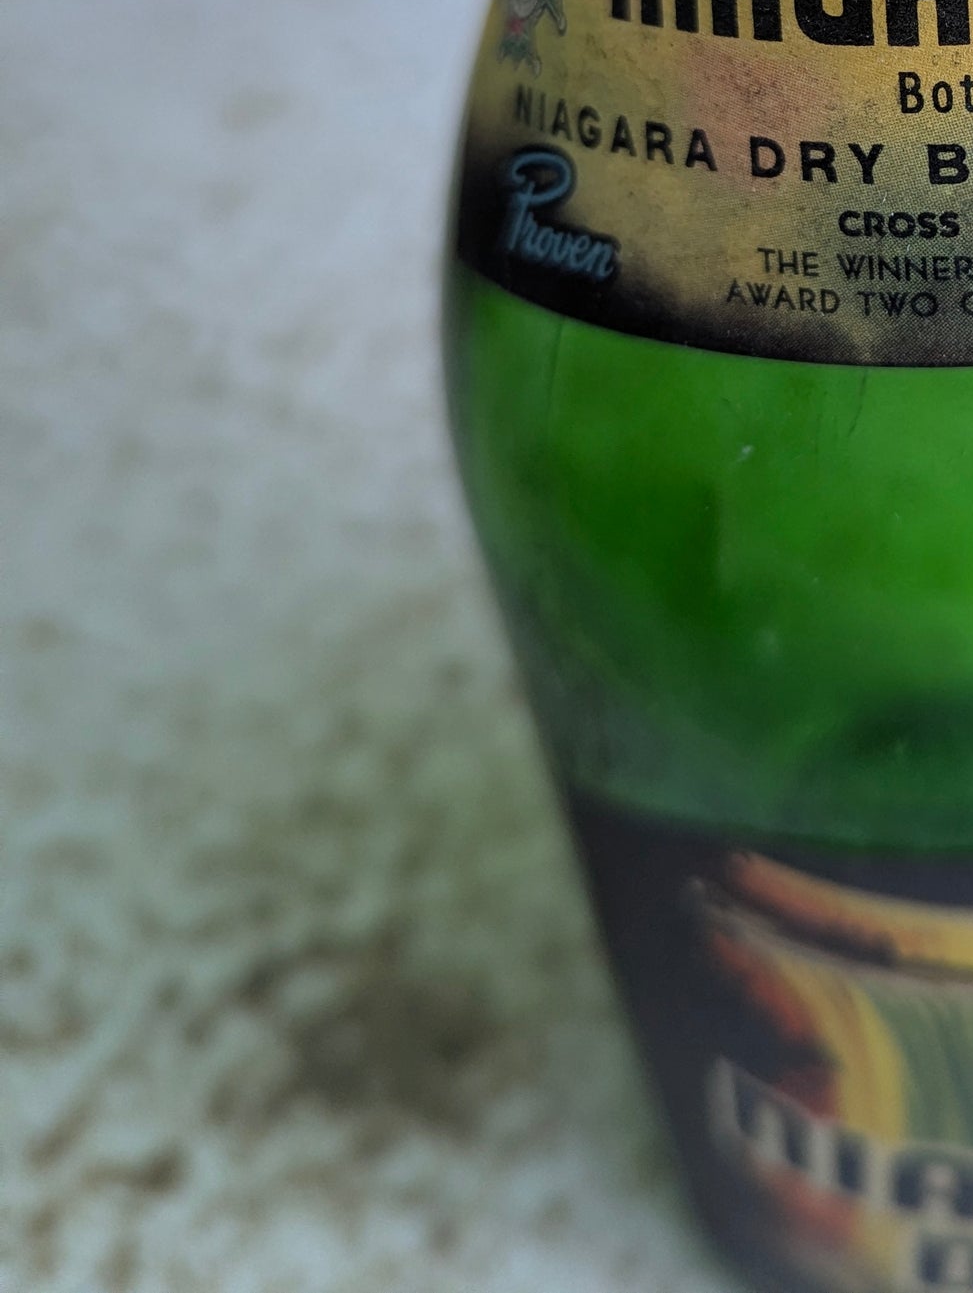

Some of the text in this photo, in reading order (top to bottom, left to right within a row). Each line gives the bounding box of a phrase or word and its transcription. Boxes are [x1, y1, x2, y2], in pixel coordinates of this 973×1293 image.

[514, 83, 718, 172] NIAGARA
[749, 136, 885, 186] DRY
[510, 152, 615, 278] Proven
[838, 210, 961, 239] CROSS
[757, 248, 820, 277] THE
[726, 278, 841, 315] AWARD
[857, 290, 940, 318] TWO
